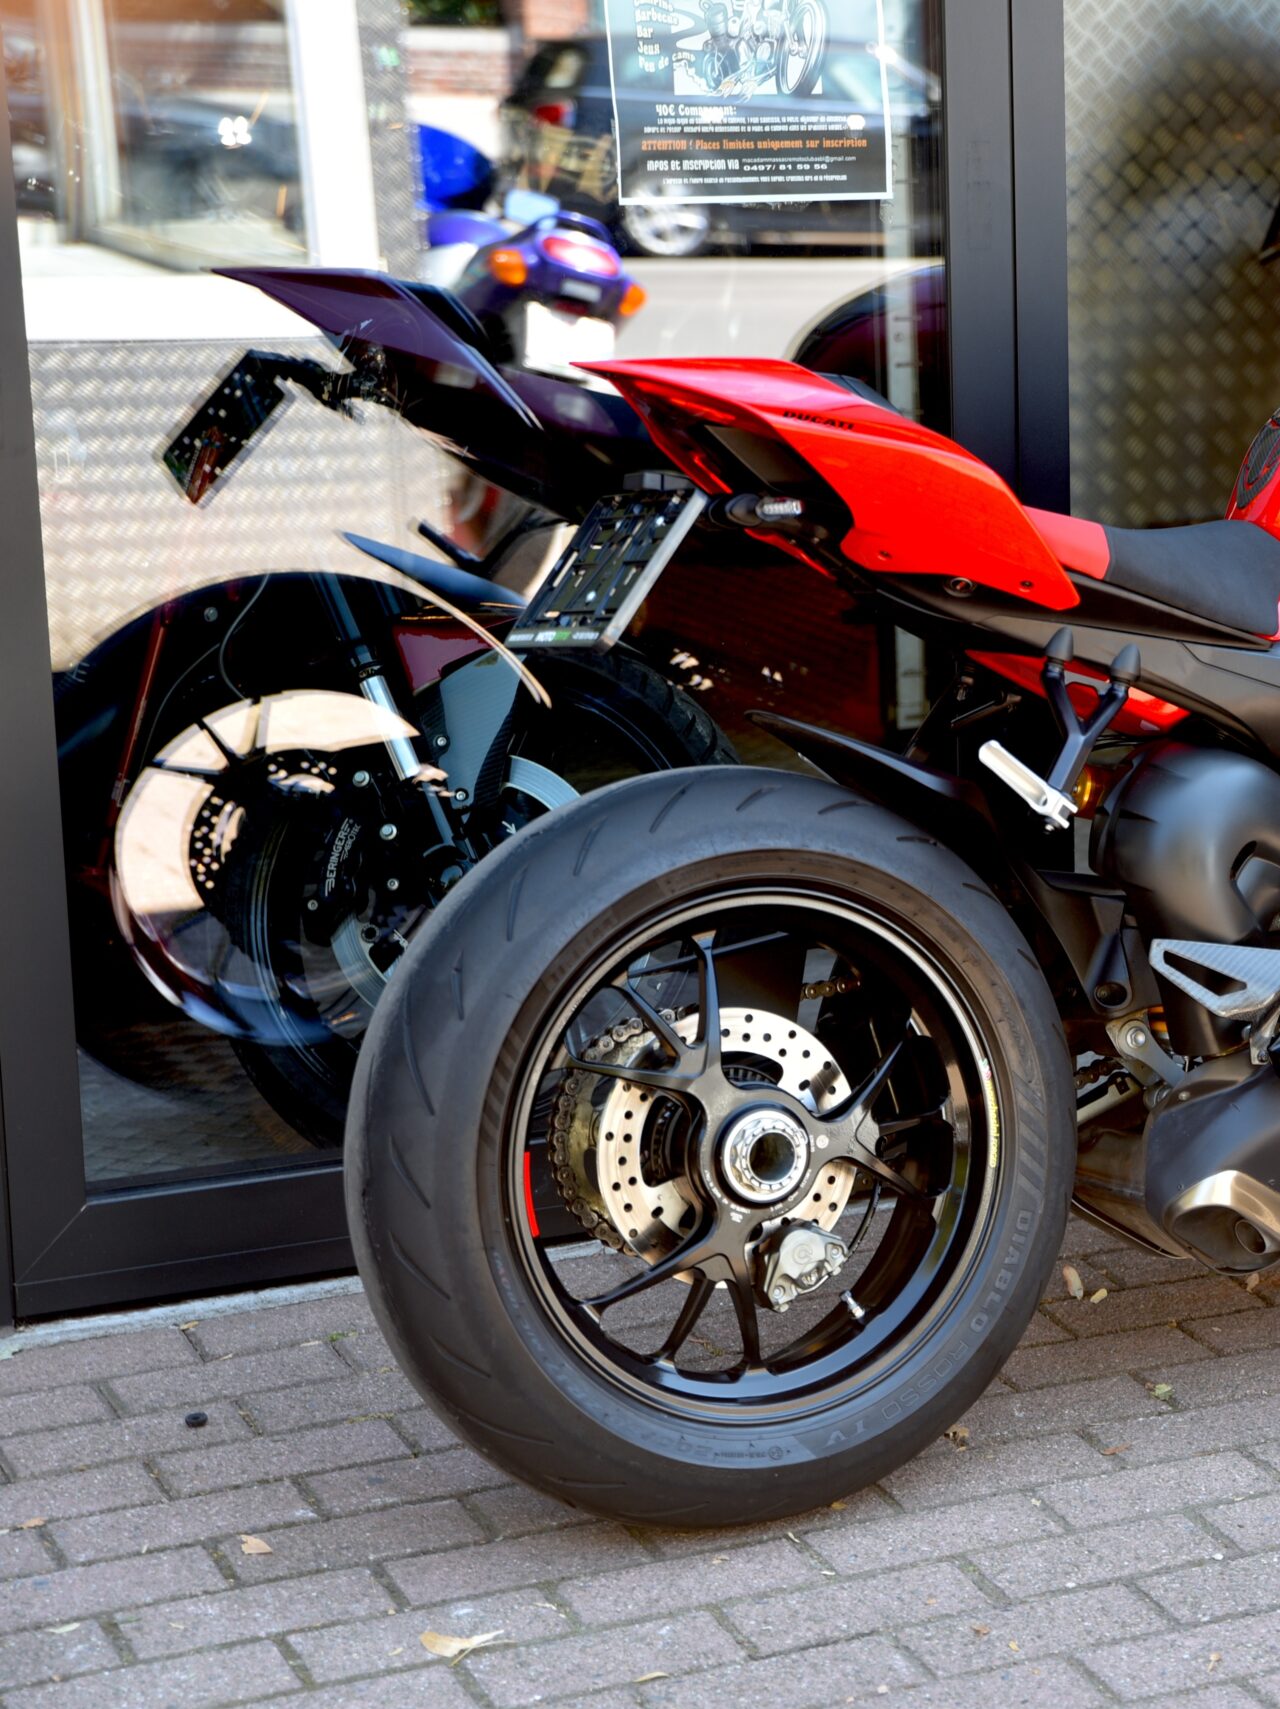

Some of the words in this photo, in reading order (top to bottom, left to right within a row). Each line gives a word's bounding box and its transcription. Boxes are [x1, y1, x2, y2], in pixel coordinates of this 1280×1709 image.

[636, 24, 653, 38] Bar
[637, 41, 660, 55] Jeux
[658, 55, 669, 70] de
[672, 51, 696, 62] camp
[655, 104, 675, 116] 40€
[695, 139, 721, 150] Places
[723, 138, 755, 149] limitées
[757, 138, 803, 150] uniquement
[806, 138, 820, 149] sur
[822, 137, 867, 148] inscription
[671, 160, 681, 171] et
[783, 411, 855, 430] DUCATI
[970, 1209, 1035, 1333] DIABLO
[881, 1338, 969, 1422] ROSSO
